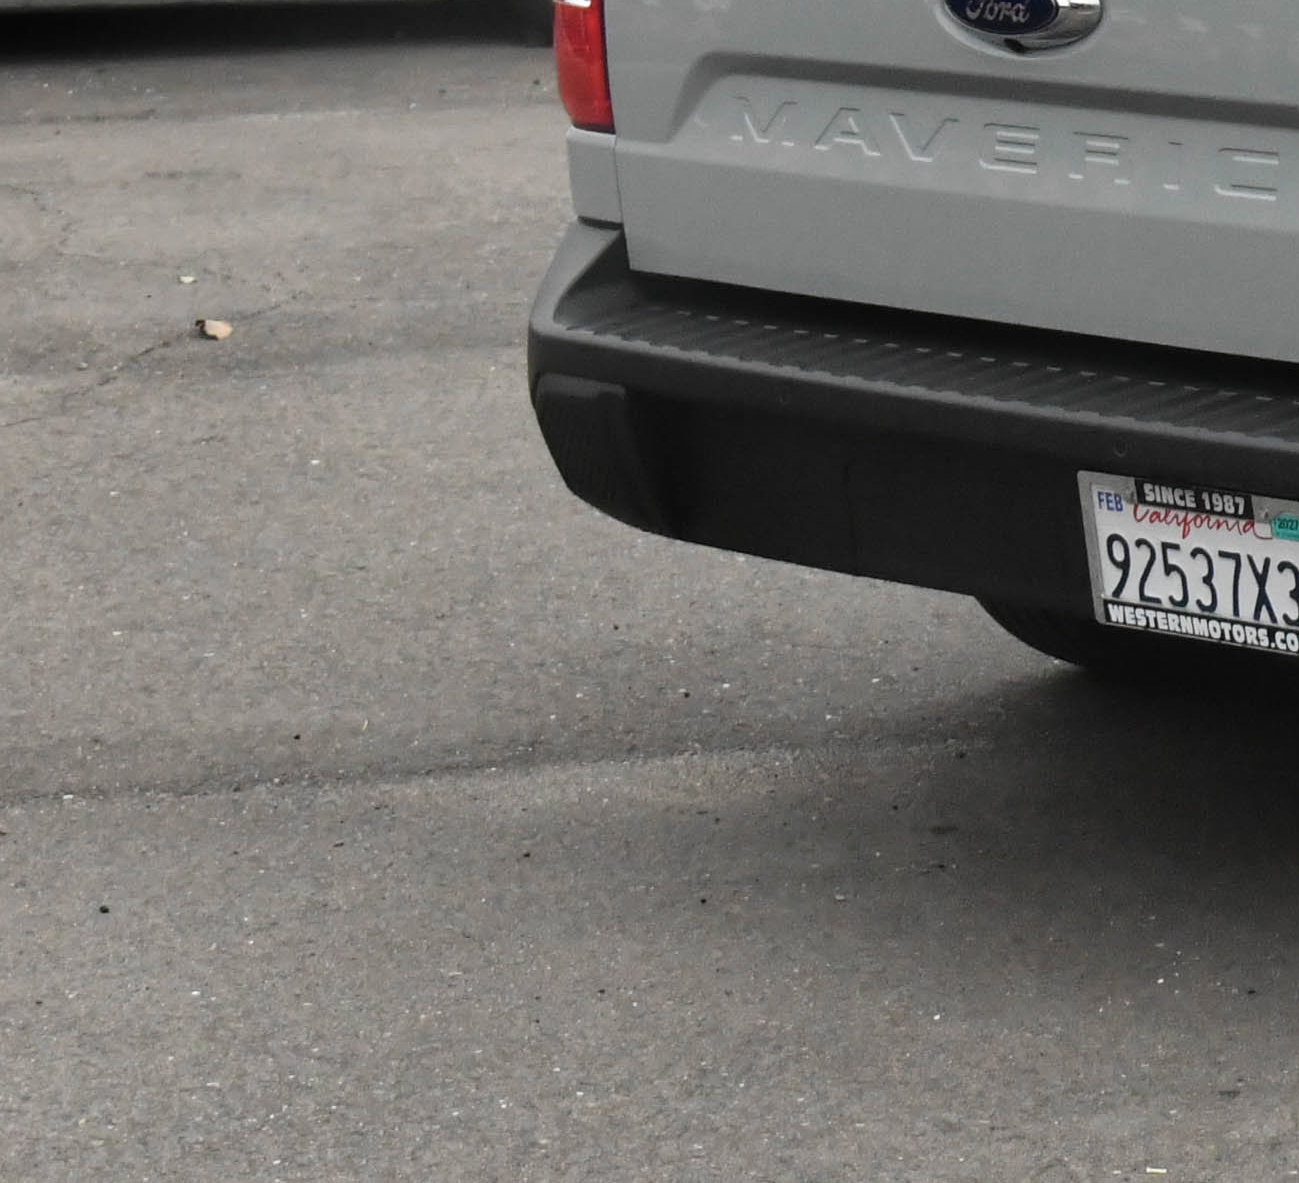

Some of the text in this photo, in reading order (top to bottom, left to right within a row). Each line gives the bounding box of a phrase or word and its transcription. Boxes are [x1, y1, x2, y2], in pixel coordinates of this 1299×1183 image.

[1096, 491, 1124, 513] FEB
[1143, 482, 1246, 516] SINCE 1987
[1132, 502, 1273, 540] California
